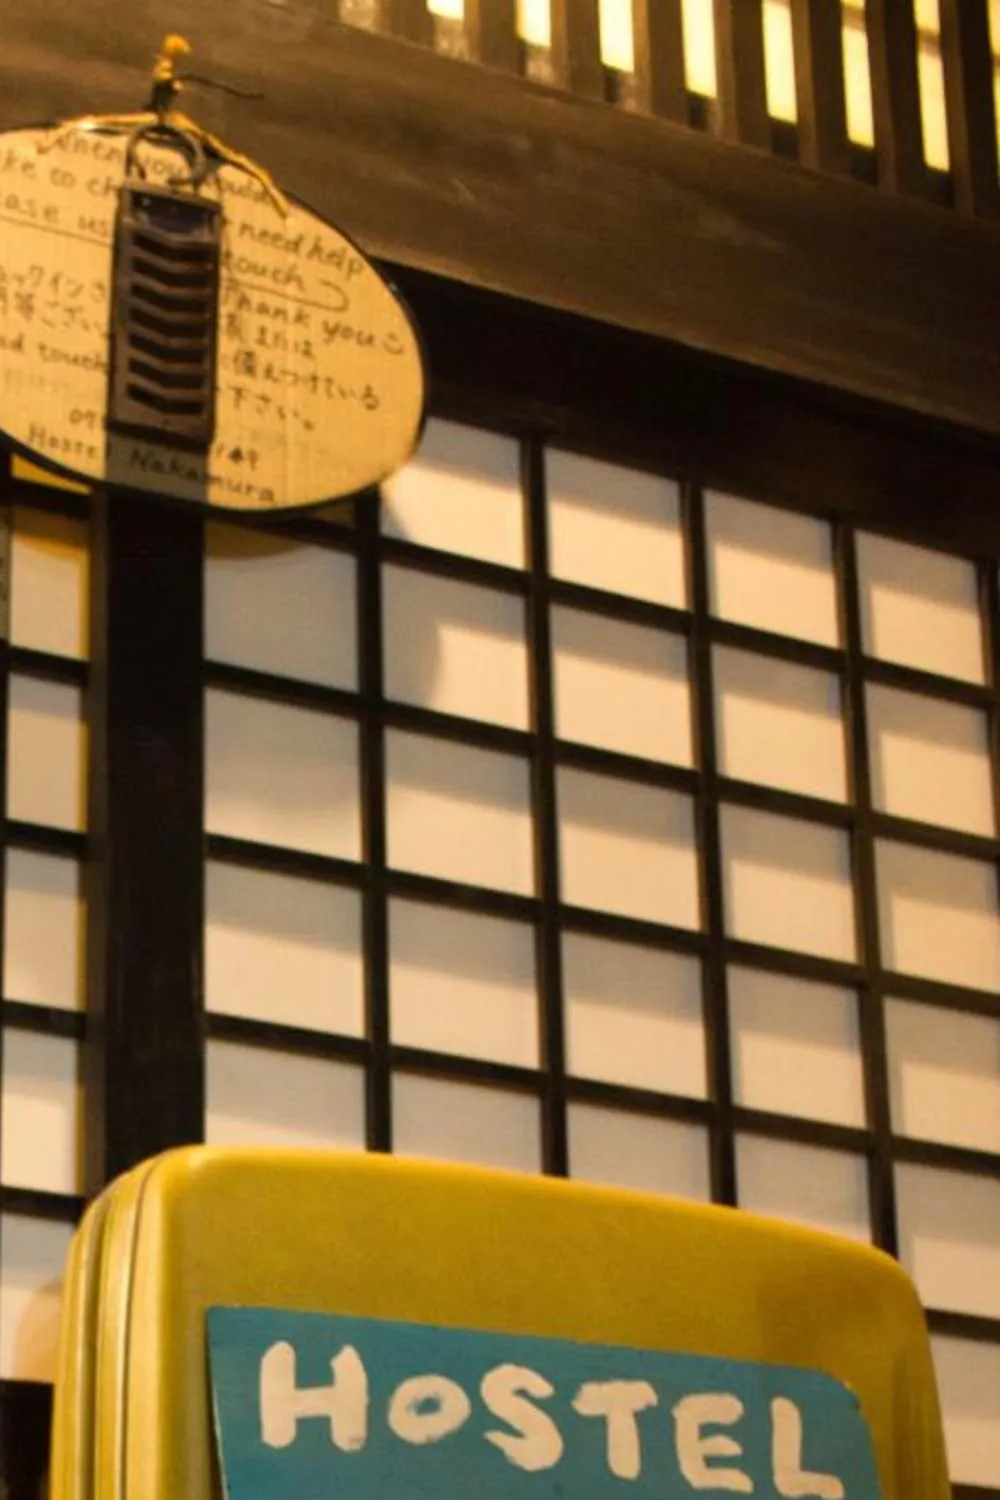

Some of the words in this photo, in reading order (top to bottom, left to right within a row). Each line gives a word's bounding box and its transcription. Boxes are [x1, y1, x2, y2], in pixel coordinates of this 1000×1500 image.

[76, 213, 110, 239] us
[238, 221, 304, 257] need
[306, 235, 364, 282] help
[321, 319, 377, 348] you
